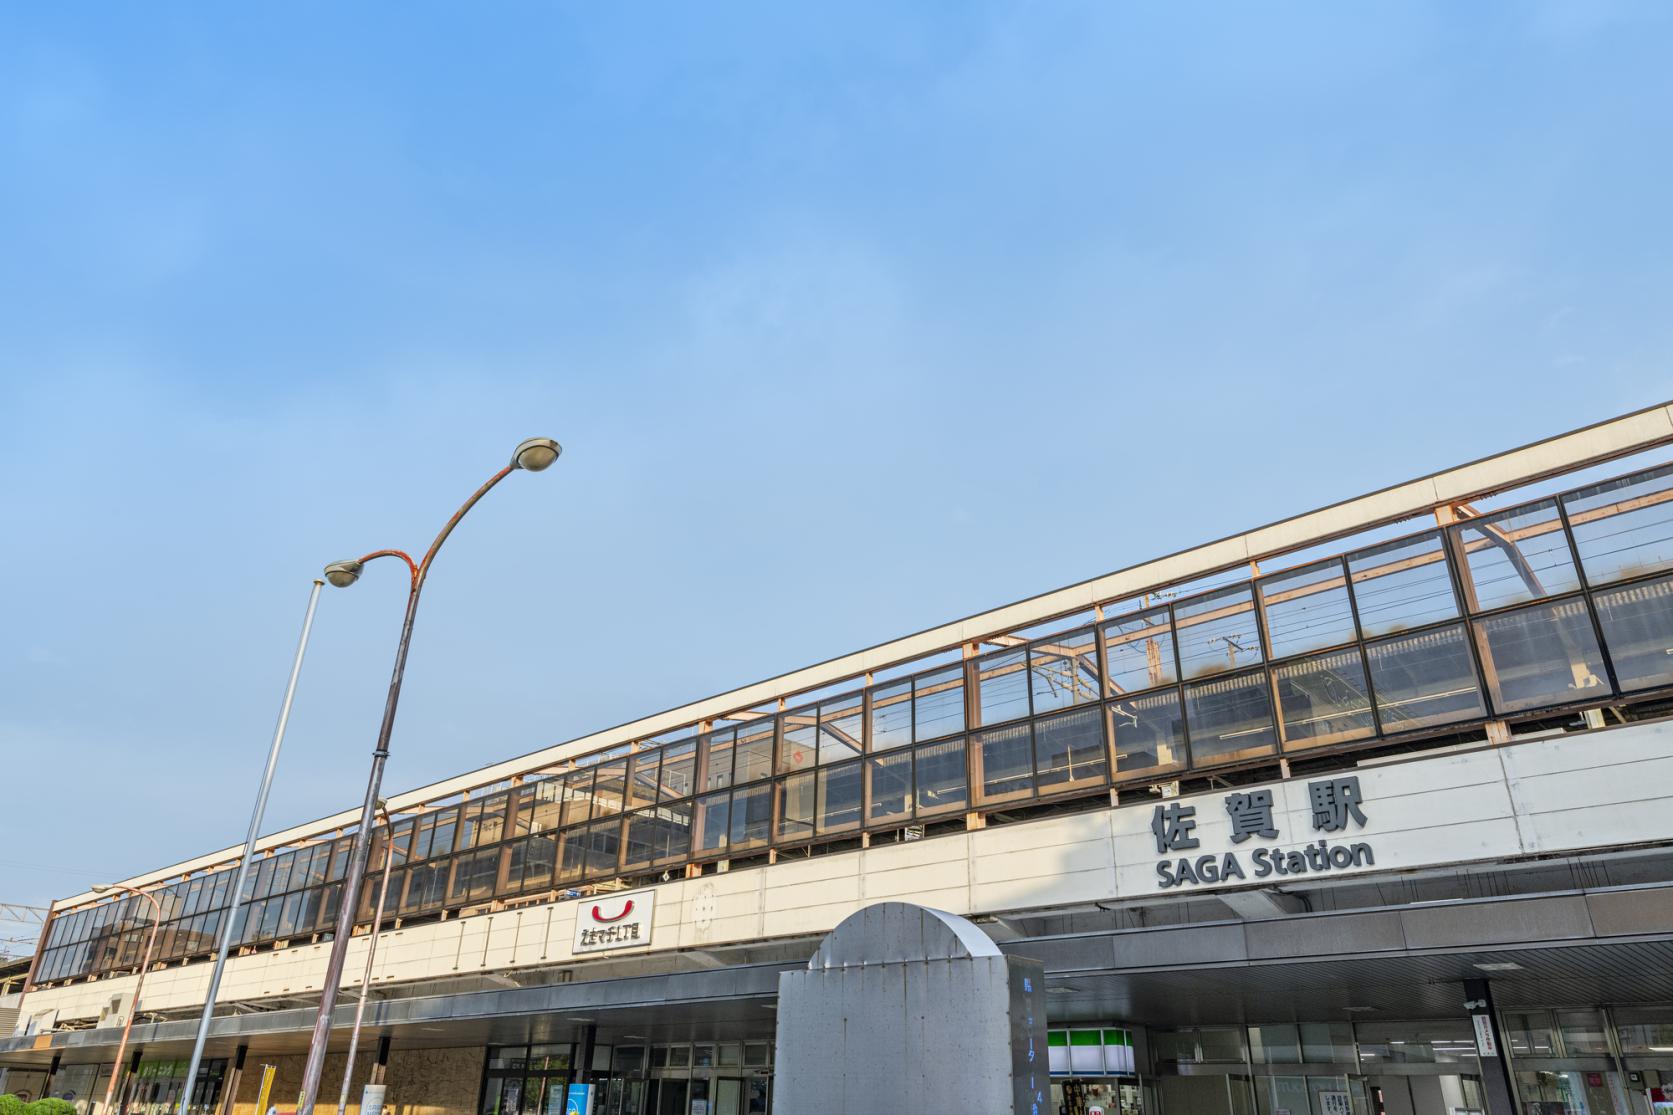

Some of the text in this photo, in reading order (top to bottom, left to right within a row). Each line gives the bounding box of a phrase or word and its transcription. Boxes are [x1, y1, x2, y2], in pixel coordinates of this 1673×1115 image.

[1151, 776, 1368, 853] 佐賀駅
[1157, 840, 1375, 888] SAGA Station
